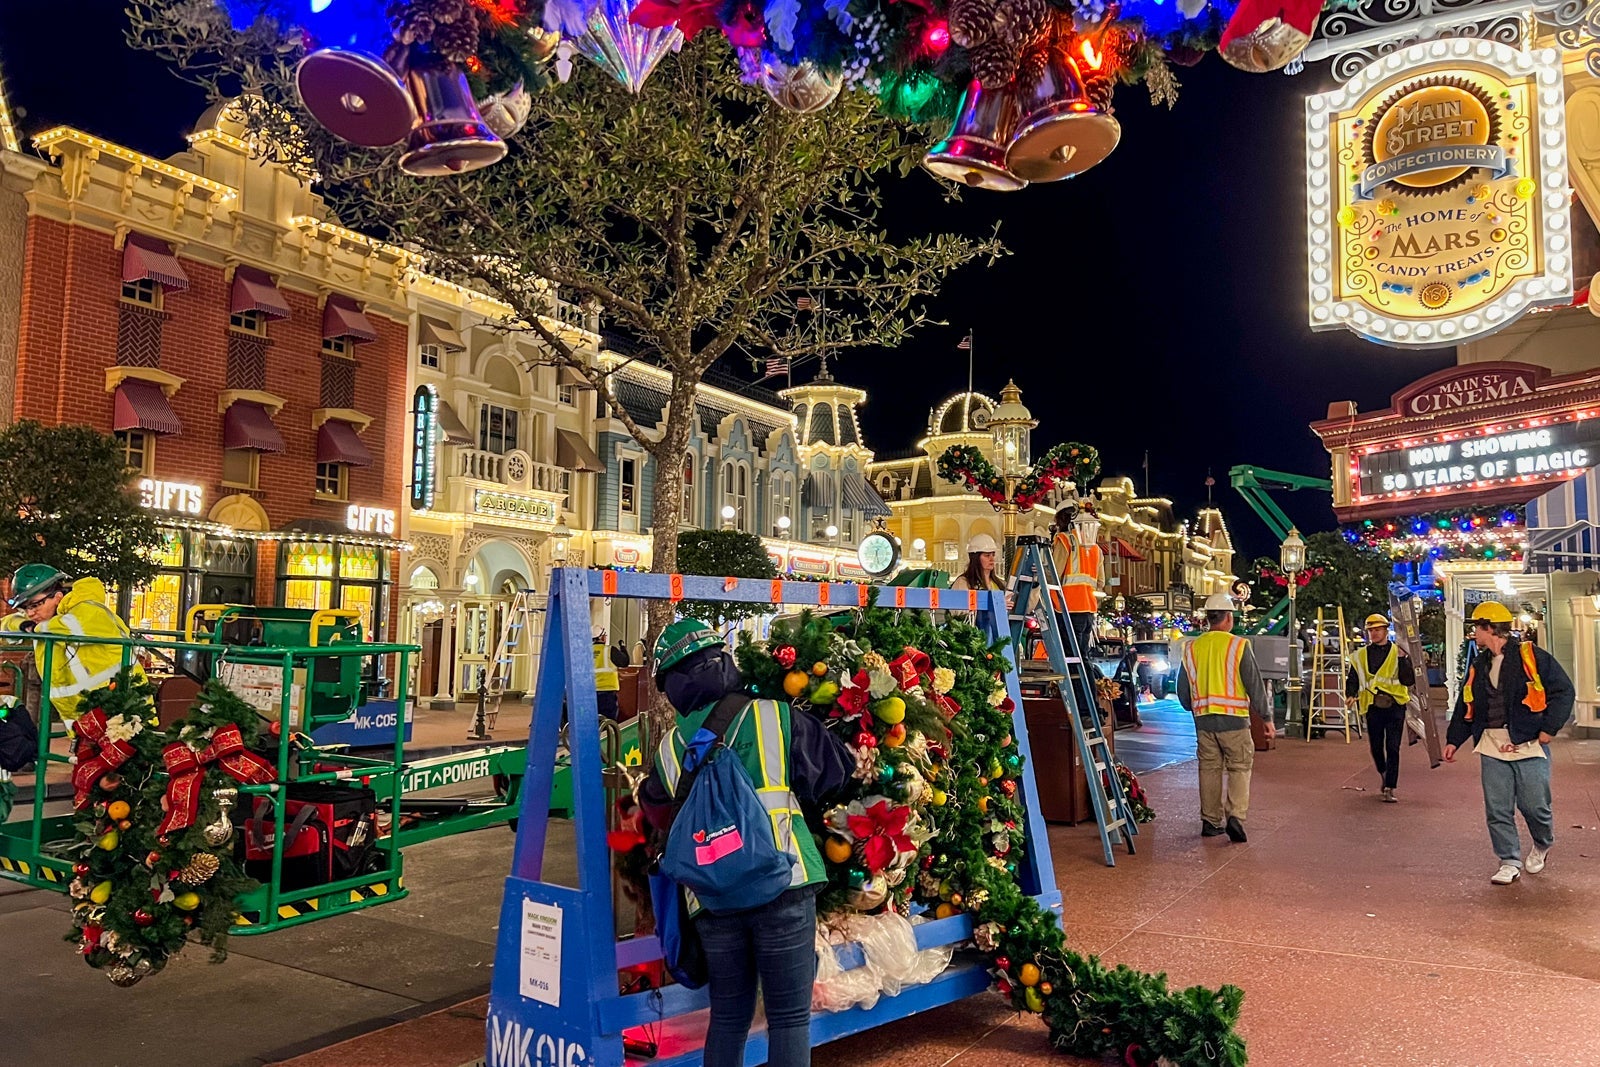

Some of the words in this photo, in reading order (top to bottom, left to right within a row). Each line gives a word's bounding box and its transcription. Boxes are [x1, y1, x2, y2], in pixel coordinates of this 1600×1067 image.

[1395, 100, 1461, 127] MAIN
[1386, 119, 1478, 155] STREET
[1366, 149, 1498, 181] CONFECTIONERY
[1385, 222, 1402, 235] The
[1406, 209, 1467, 228] HOME
[1470, 211, 1485, 222] of
[1390, 229, 1481, 259] MARS
[1376, 262, 1430, 277] CANDY
[1435, 247, 1494, 275] TREATS
[1411, 376, 1533, 414] CINEMA
[1439, 377, 1479, 394] MAIN
[414, 395, 426, 499] ARCADE
[1409, 445, 1450, 466] NOW
[1461, 429, 1551, 458] SHOWING
[1383, 474, 1407, 491] 50
[1413, 464, 1475, 487] YEARS
[1480, 460, 1508, 478] OF
[1516, 449, 1588, 474] MAGIC
[140, 479, 202, 513] GIFTS
[482, 497, 548, 516] ARCADE
[347, 504, 395, 534] GIFTS
[671, 576, 682, 597] 8
[401, 770, 431, 794] LIFT
[442, 760, 489, 785] POWER
